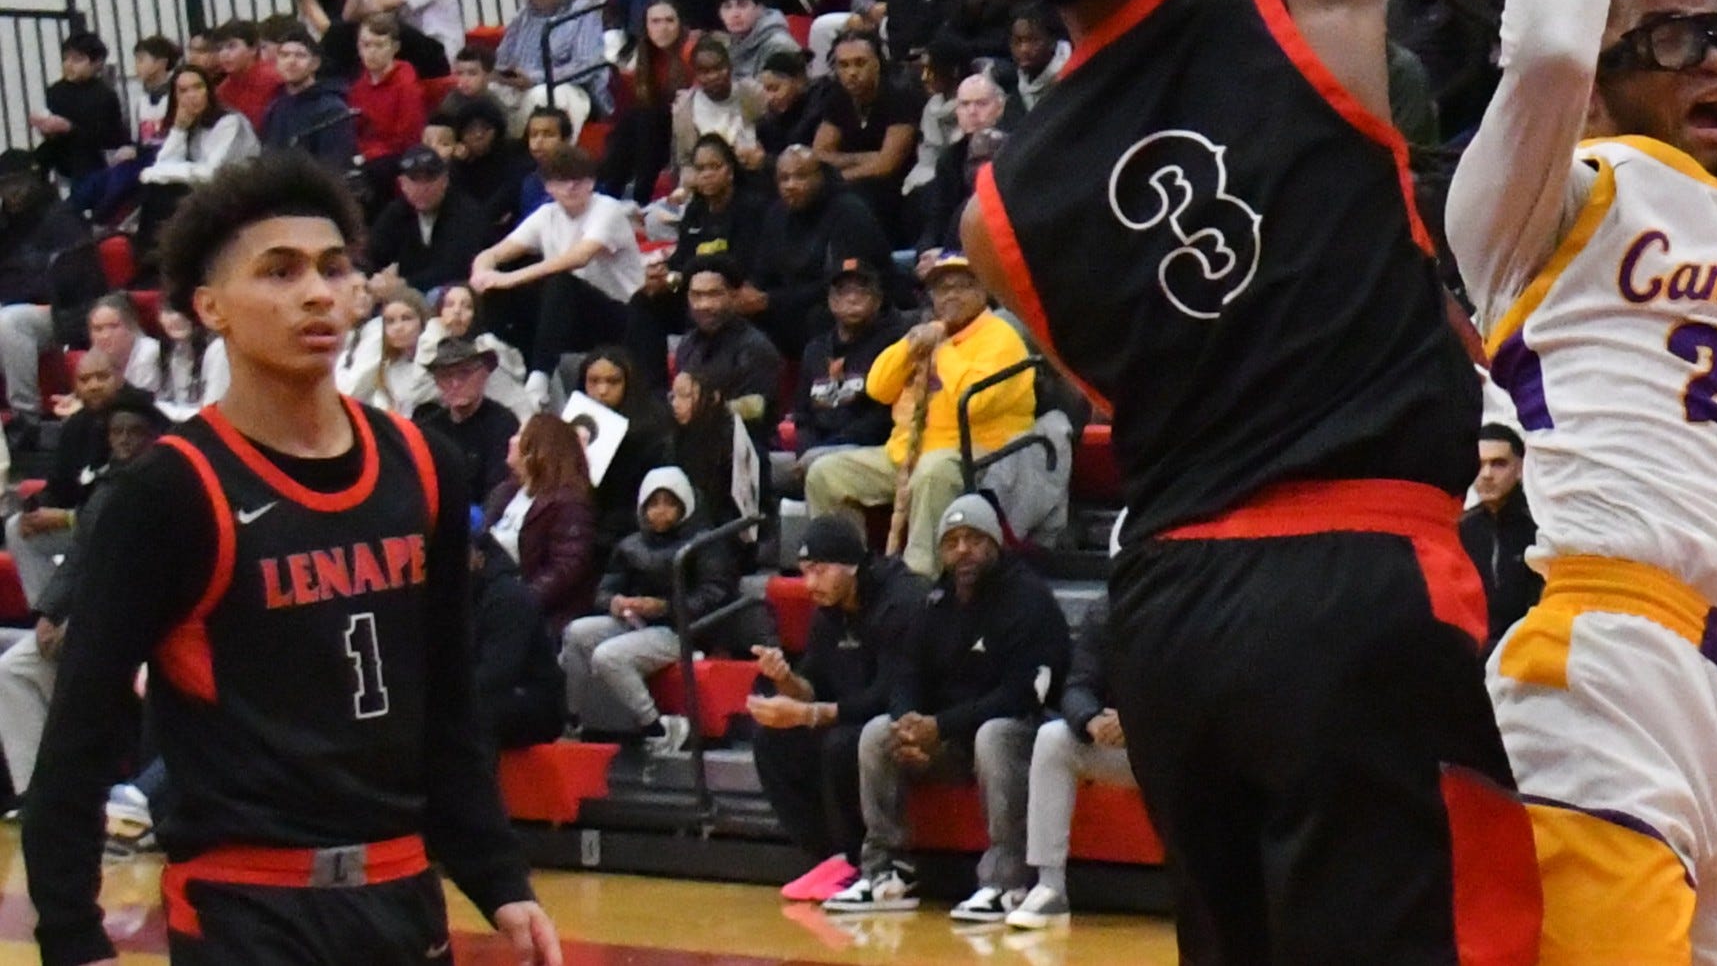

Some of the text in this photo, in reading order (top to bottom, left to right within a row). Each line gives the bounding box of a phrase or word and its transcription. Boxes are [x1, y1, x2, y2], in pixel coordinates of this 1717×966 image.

[1108, 129, 1263, 319] 3
[260, 533, 427, 609] LENAPE
[345, 612, 389, 720] 1
